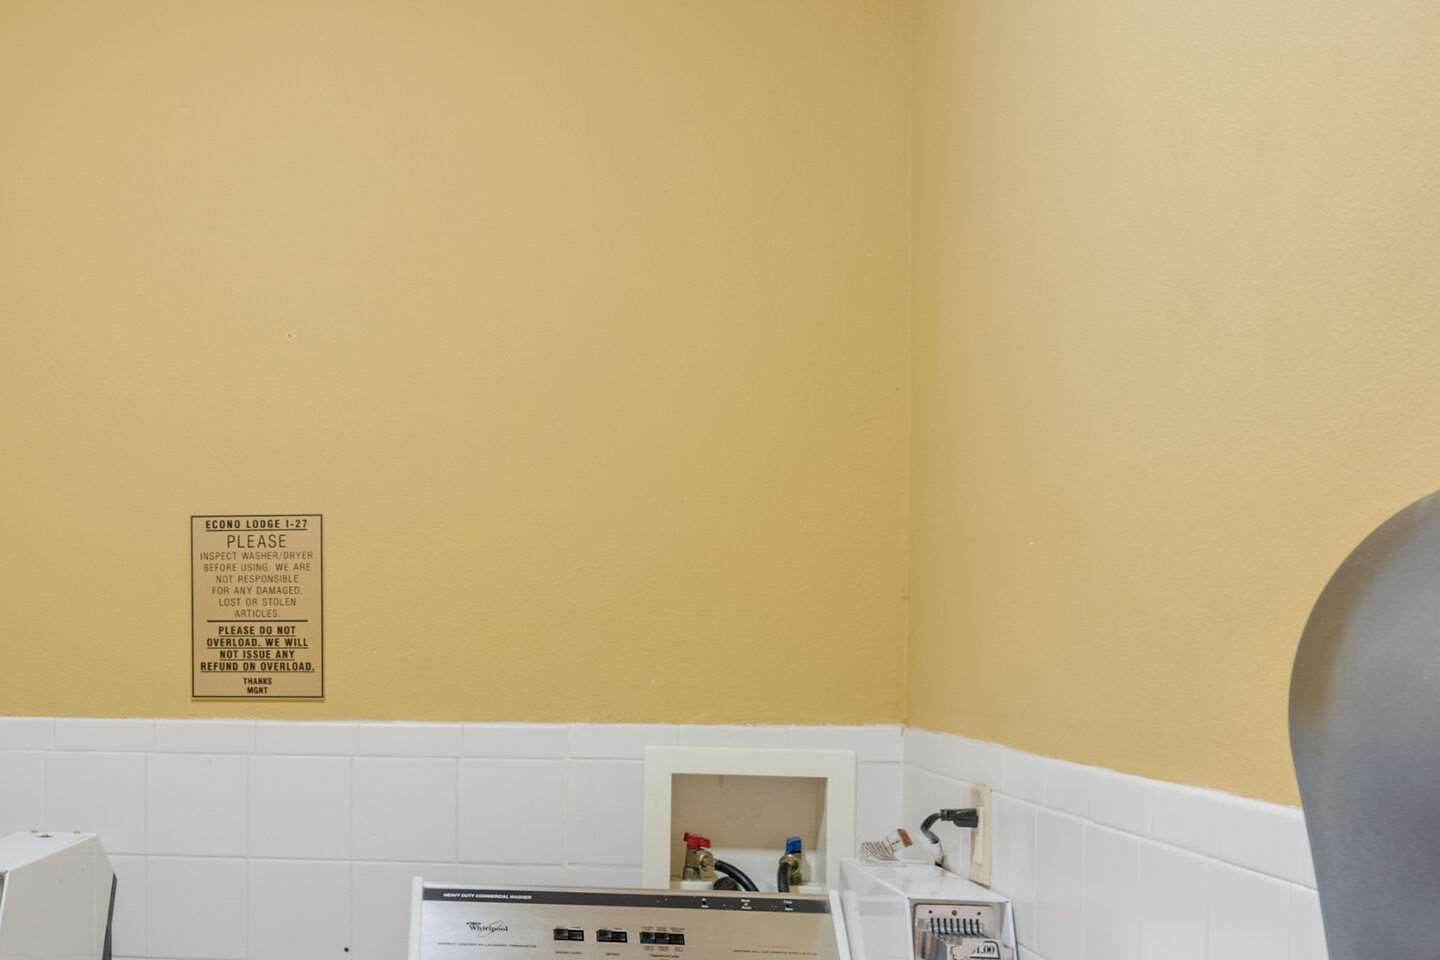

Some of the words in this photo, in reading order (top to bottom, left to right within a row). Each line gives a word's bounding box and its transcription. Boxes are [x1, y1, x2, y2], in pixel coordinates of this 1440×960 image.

[205, 520, 241, 529] ECONO
[246, 519, 280, 529] LODGE
[286, 519, 308, 528] I-27
[227, 534, 287, 549] PLEASE
[200, 551, 237, 560] INSPECT
[242, 551, 313, 560] WASHER/DRYER
[203, 563, 237, 572] BEFORE
[275, 563, 288, 572] WE
[293, 563, 311, 571] ARE
[216, 575, 232, 583] NOT
[237, 574, 299, 583] RESPONSIBLE
[211, 586, 230, 595] FOR
[233, 586, 252, 595] ANY
[218, 598, 241, 607] LOST
[245, 598, 258, 606] OR
[262, 597, 297, 606] STOLEN
[218, 626, 255, 635] PLEASE
[259, 626, 272, 635] DO
[277, 626, 296, 635] NOT
[265, 638, 280, 647] WE
[285, 638, 308, 647] WILL
[220, 650, 238, 659] NOT
[243, 650, 271, 659] ISSUE
[275, 650, 295, 659] ANY
[200, 662, 238, 671] REFUND
[243, 662, 256, 671] ON
[243, 677, 272, 685] THANKS
[468, 924, 509, 933] Whirlpool
